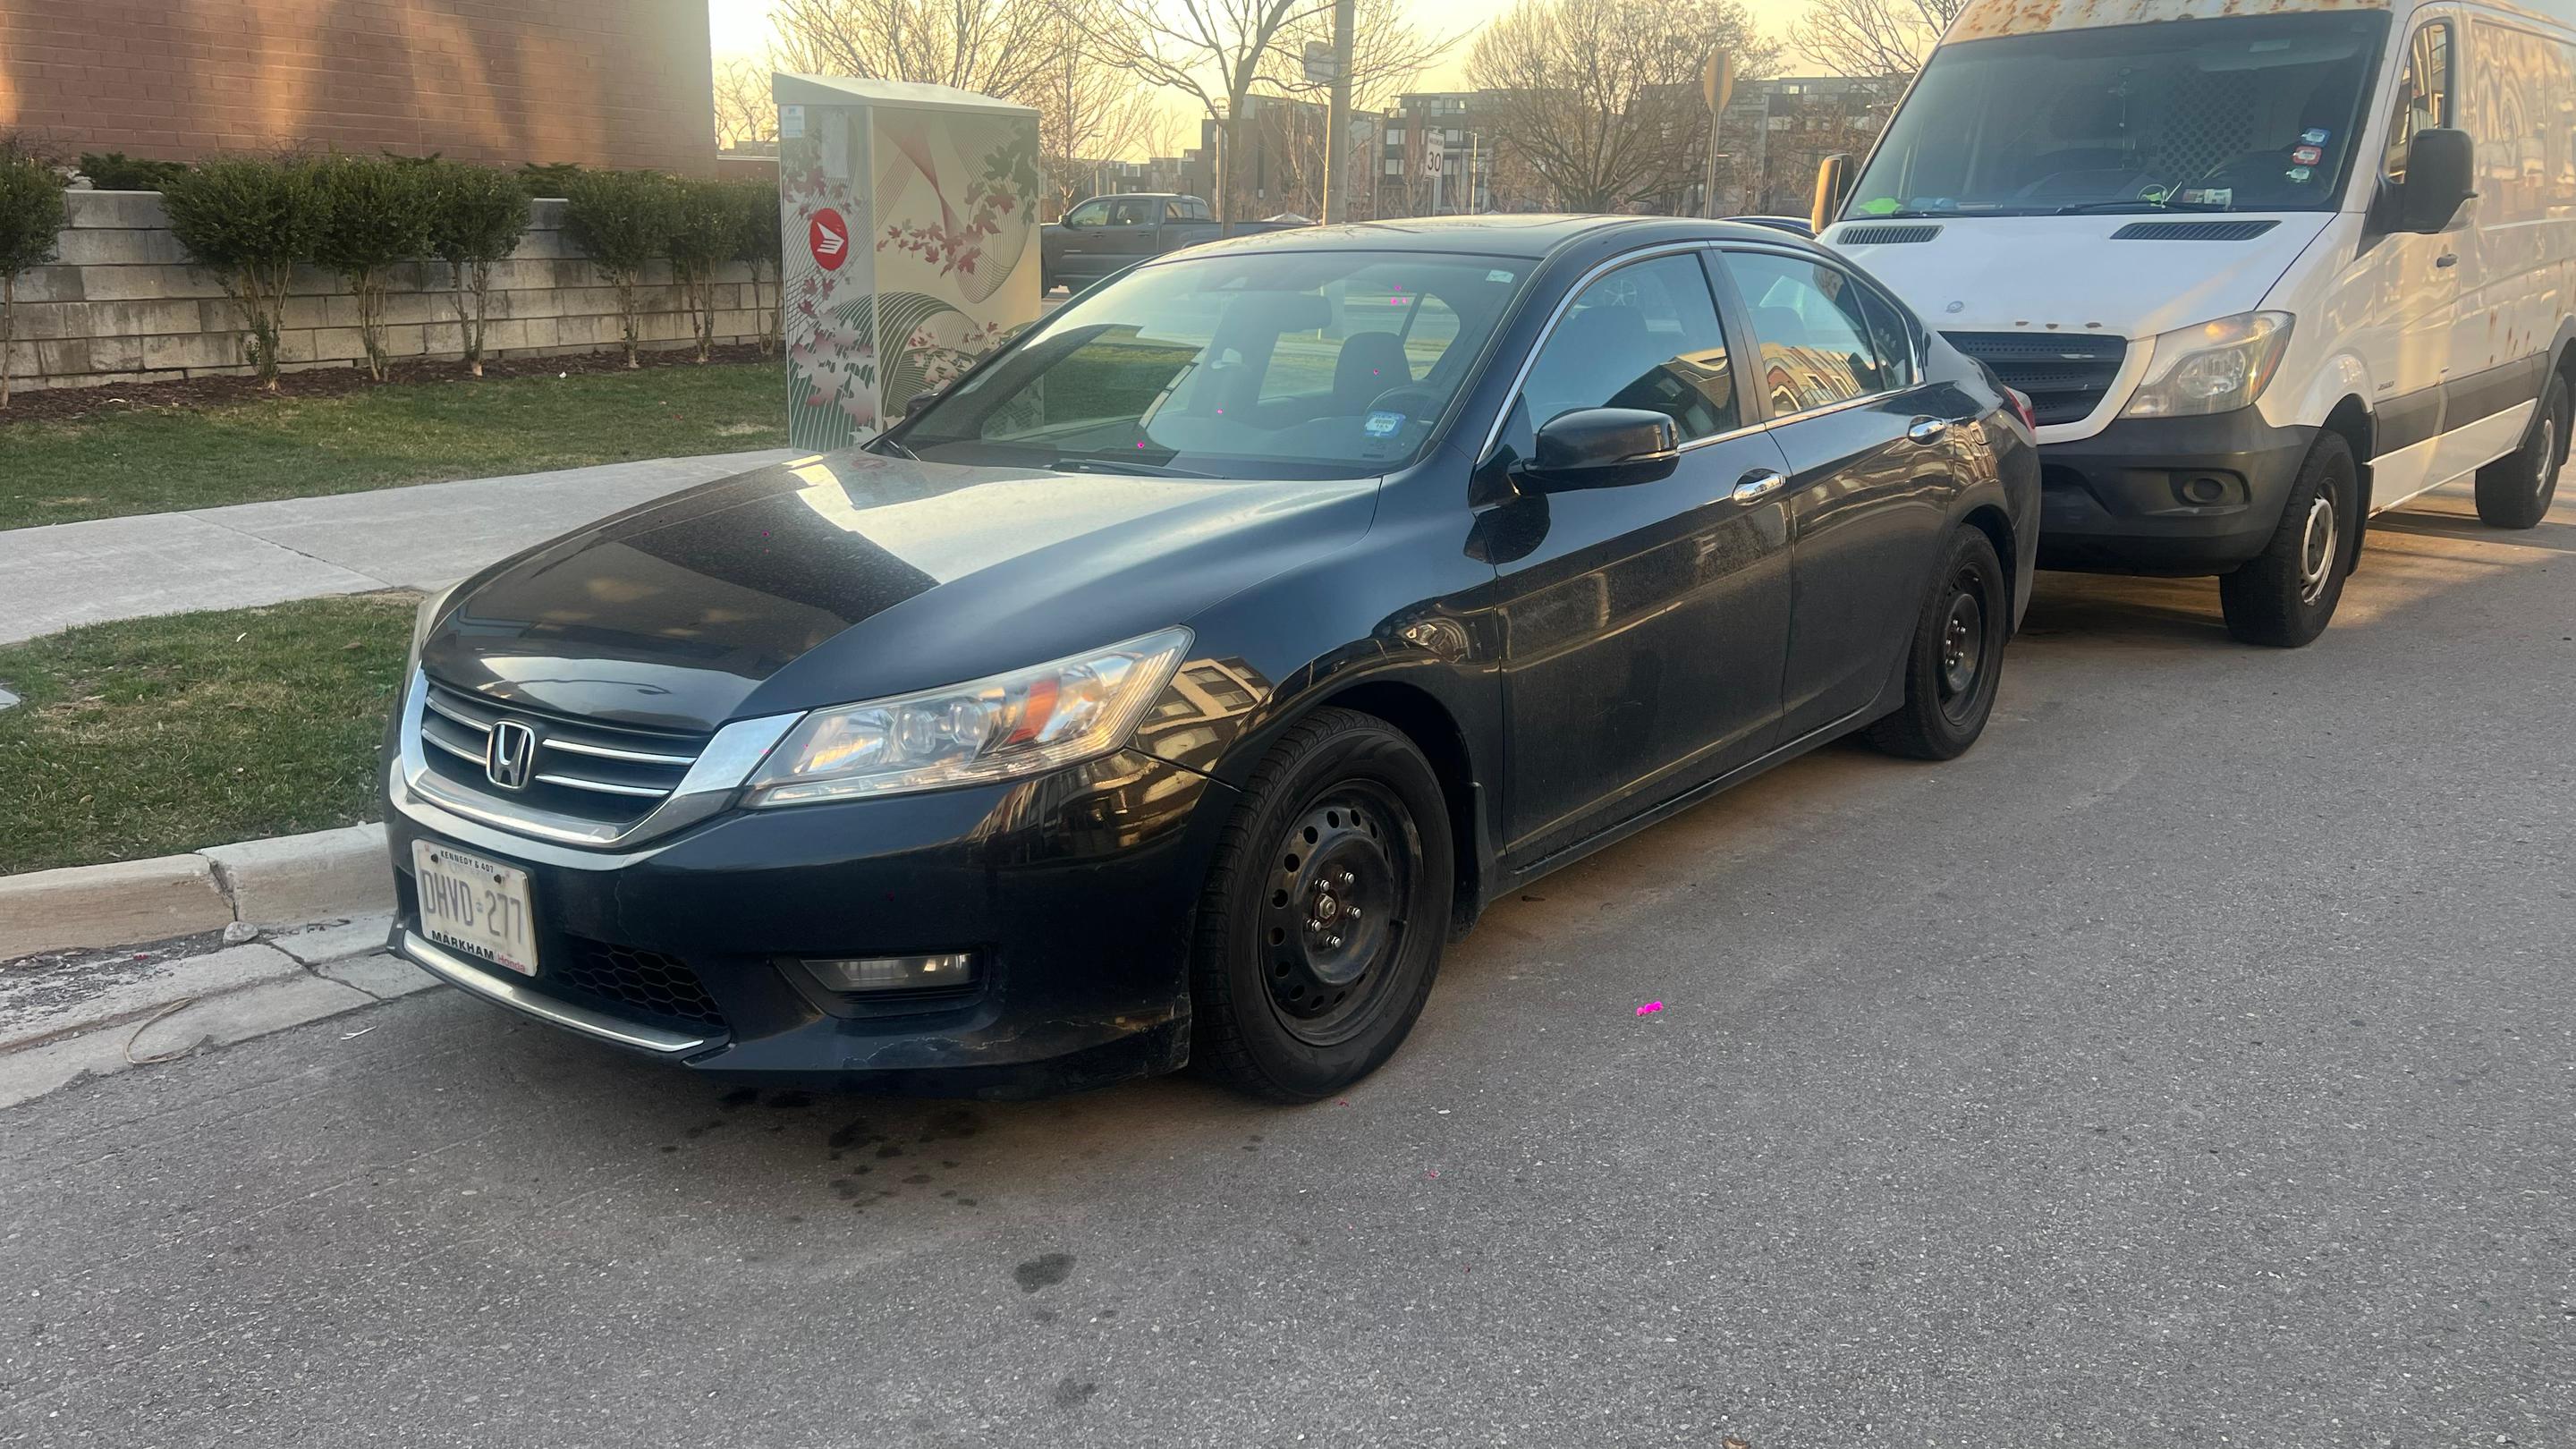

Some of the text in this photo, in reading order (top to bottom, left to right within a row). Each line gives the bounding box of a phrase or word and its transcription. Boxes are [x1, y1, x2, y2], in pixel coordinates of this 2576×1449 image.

[1428, 151, 1441, 172] 30
[440, 850, 472, 866] KENNEDY
[481, 863, 494, 874] 407
[432, 930, 526, 972] MARKHAM Honda
